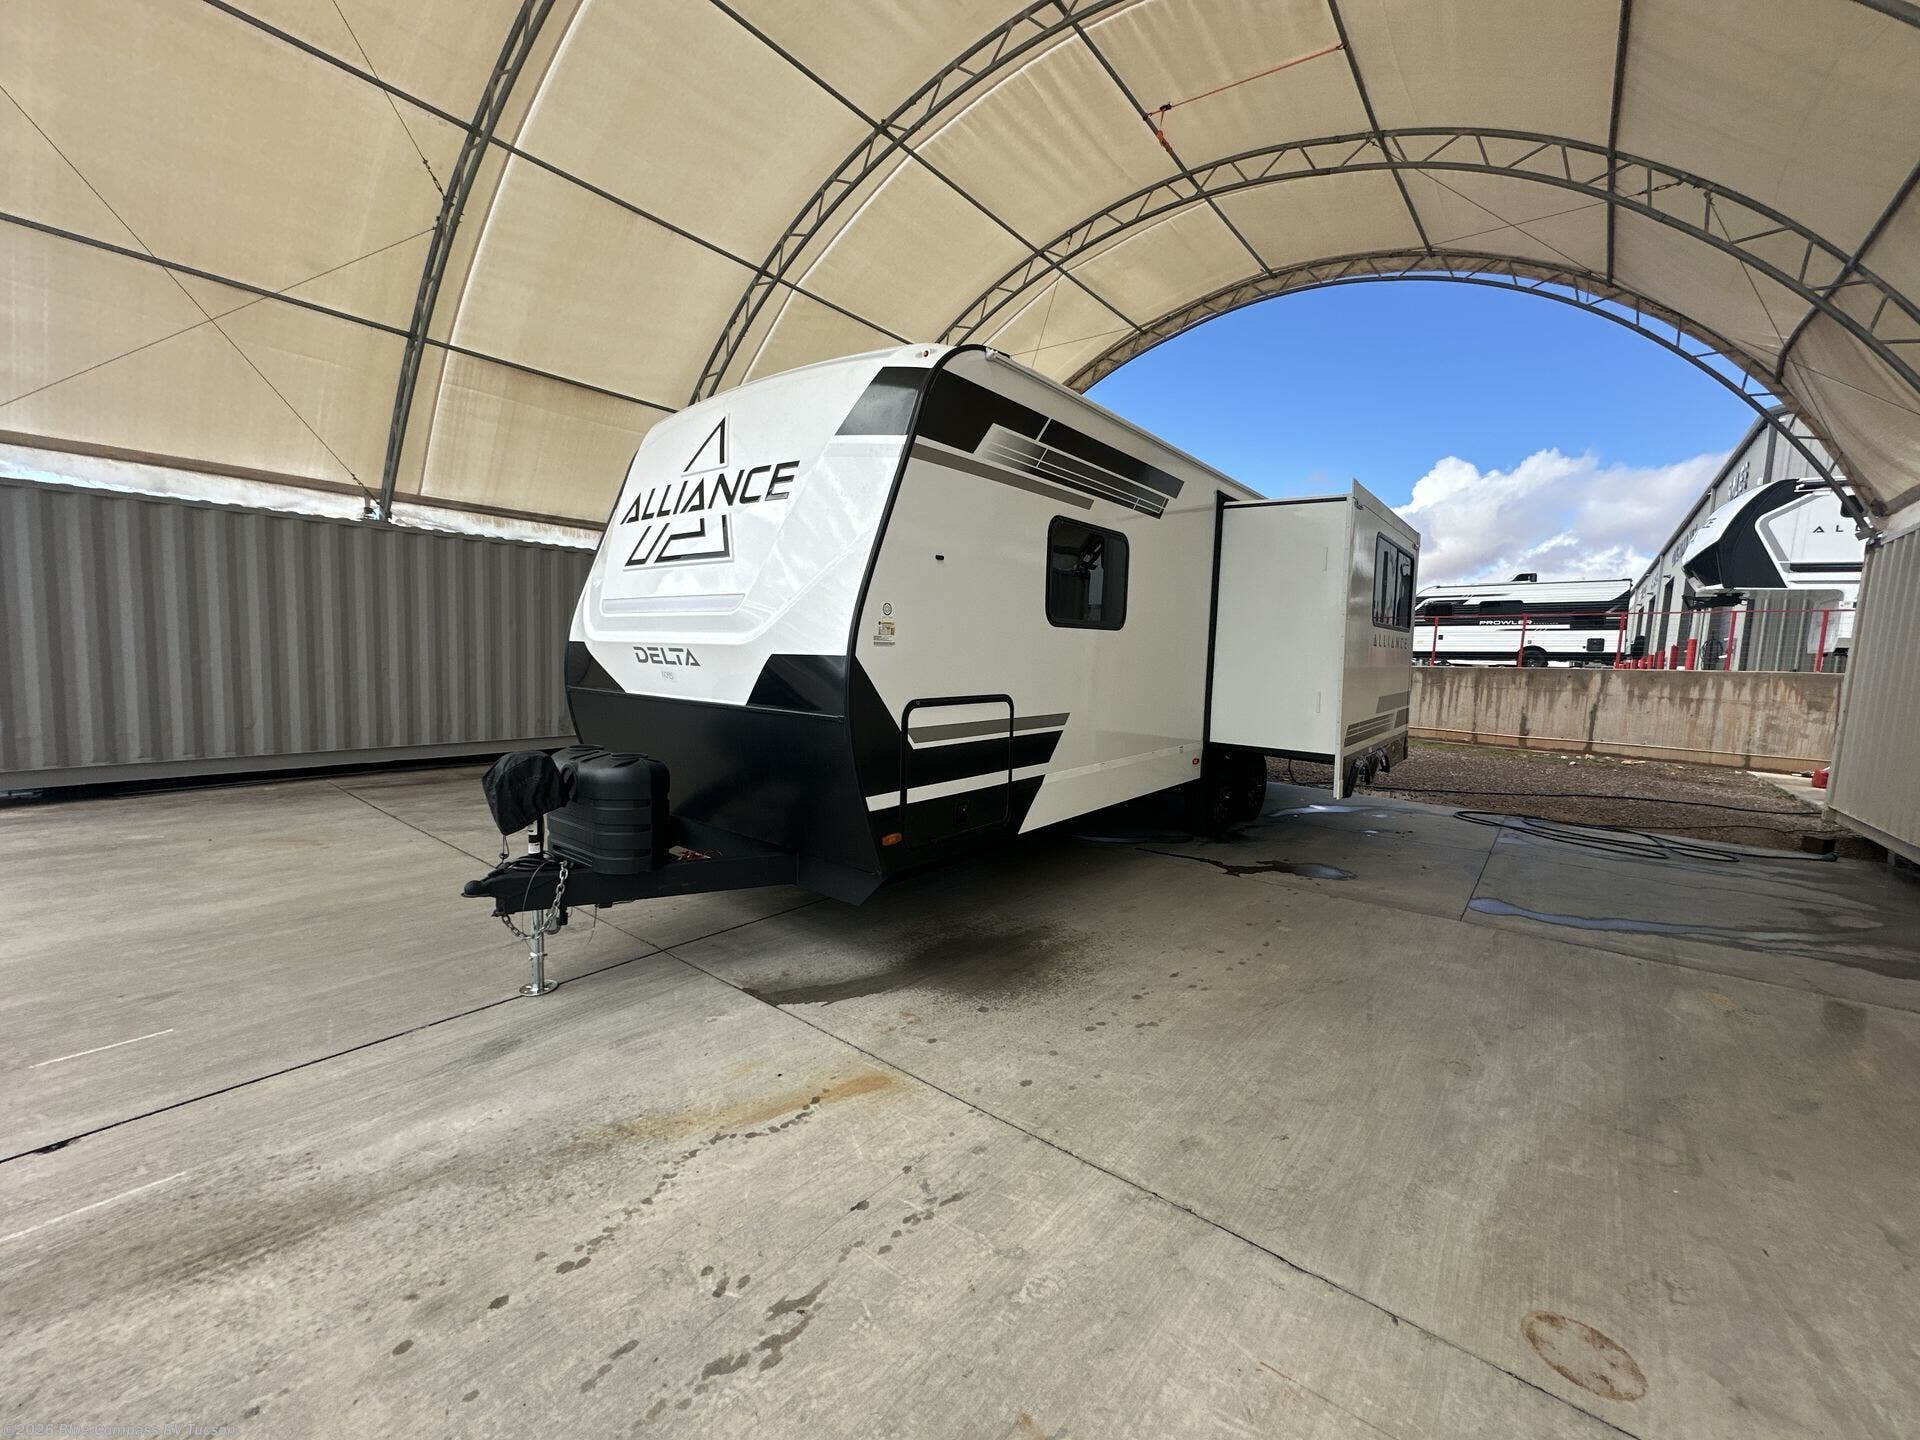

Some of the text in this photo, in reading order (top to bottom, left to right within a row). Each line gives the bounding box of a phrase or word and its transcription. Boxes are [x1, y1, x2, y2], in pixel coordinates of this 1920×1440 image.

[620, 460, 800, 525] ALLIANCE
[1374, 633, 1408, 650] ALLIANCE
[633, 646, 701, 667] DELTA
